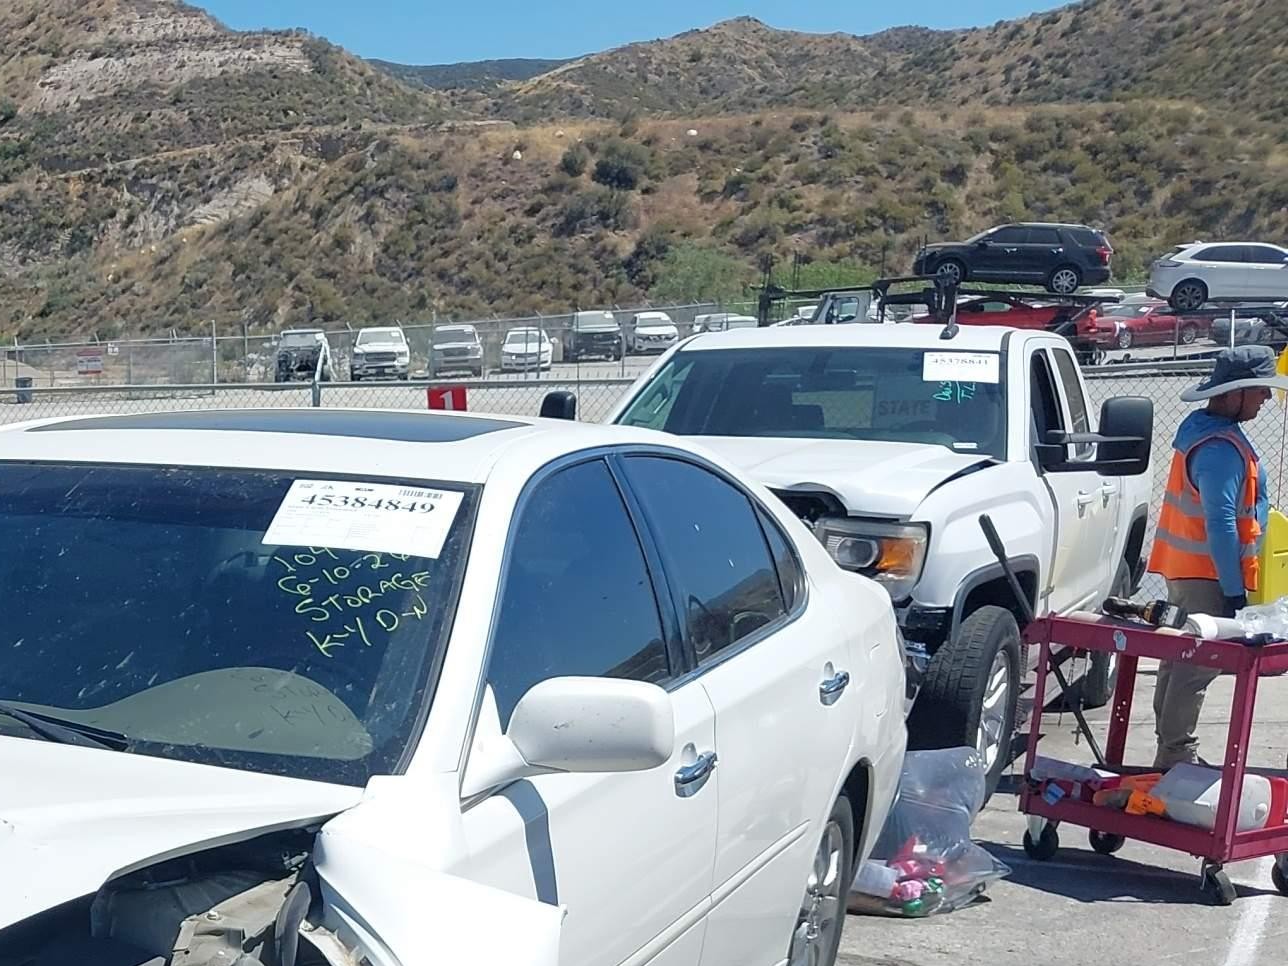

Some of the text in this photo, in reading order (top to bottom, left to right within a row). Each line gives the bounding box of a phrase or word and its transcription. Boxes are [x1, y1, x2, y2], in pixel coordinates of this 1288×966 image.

[439, 389, 454, 410] 1
[301, 494, 435, 514] 45384849
[295, 570, 431, 622] STORAGE
